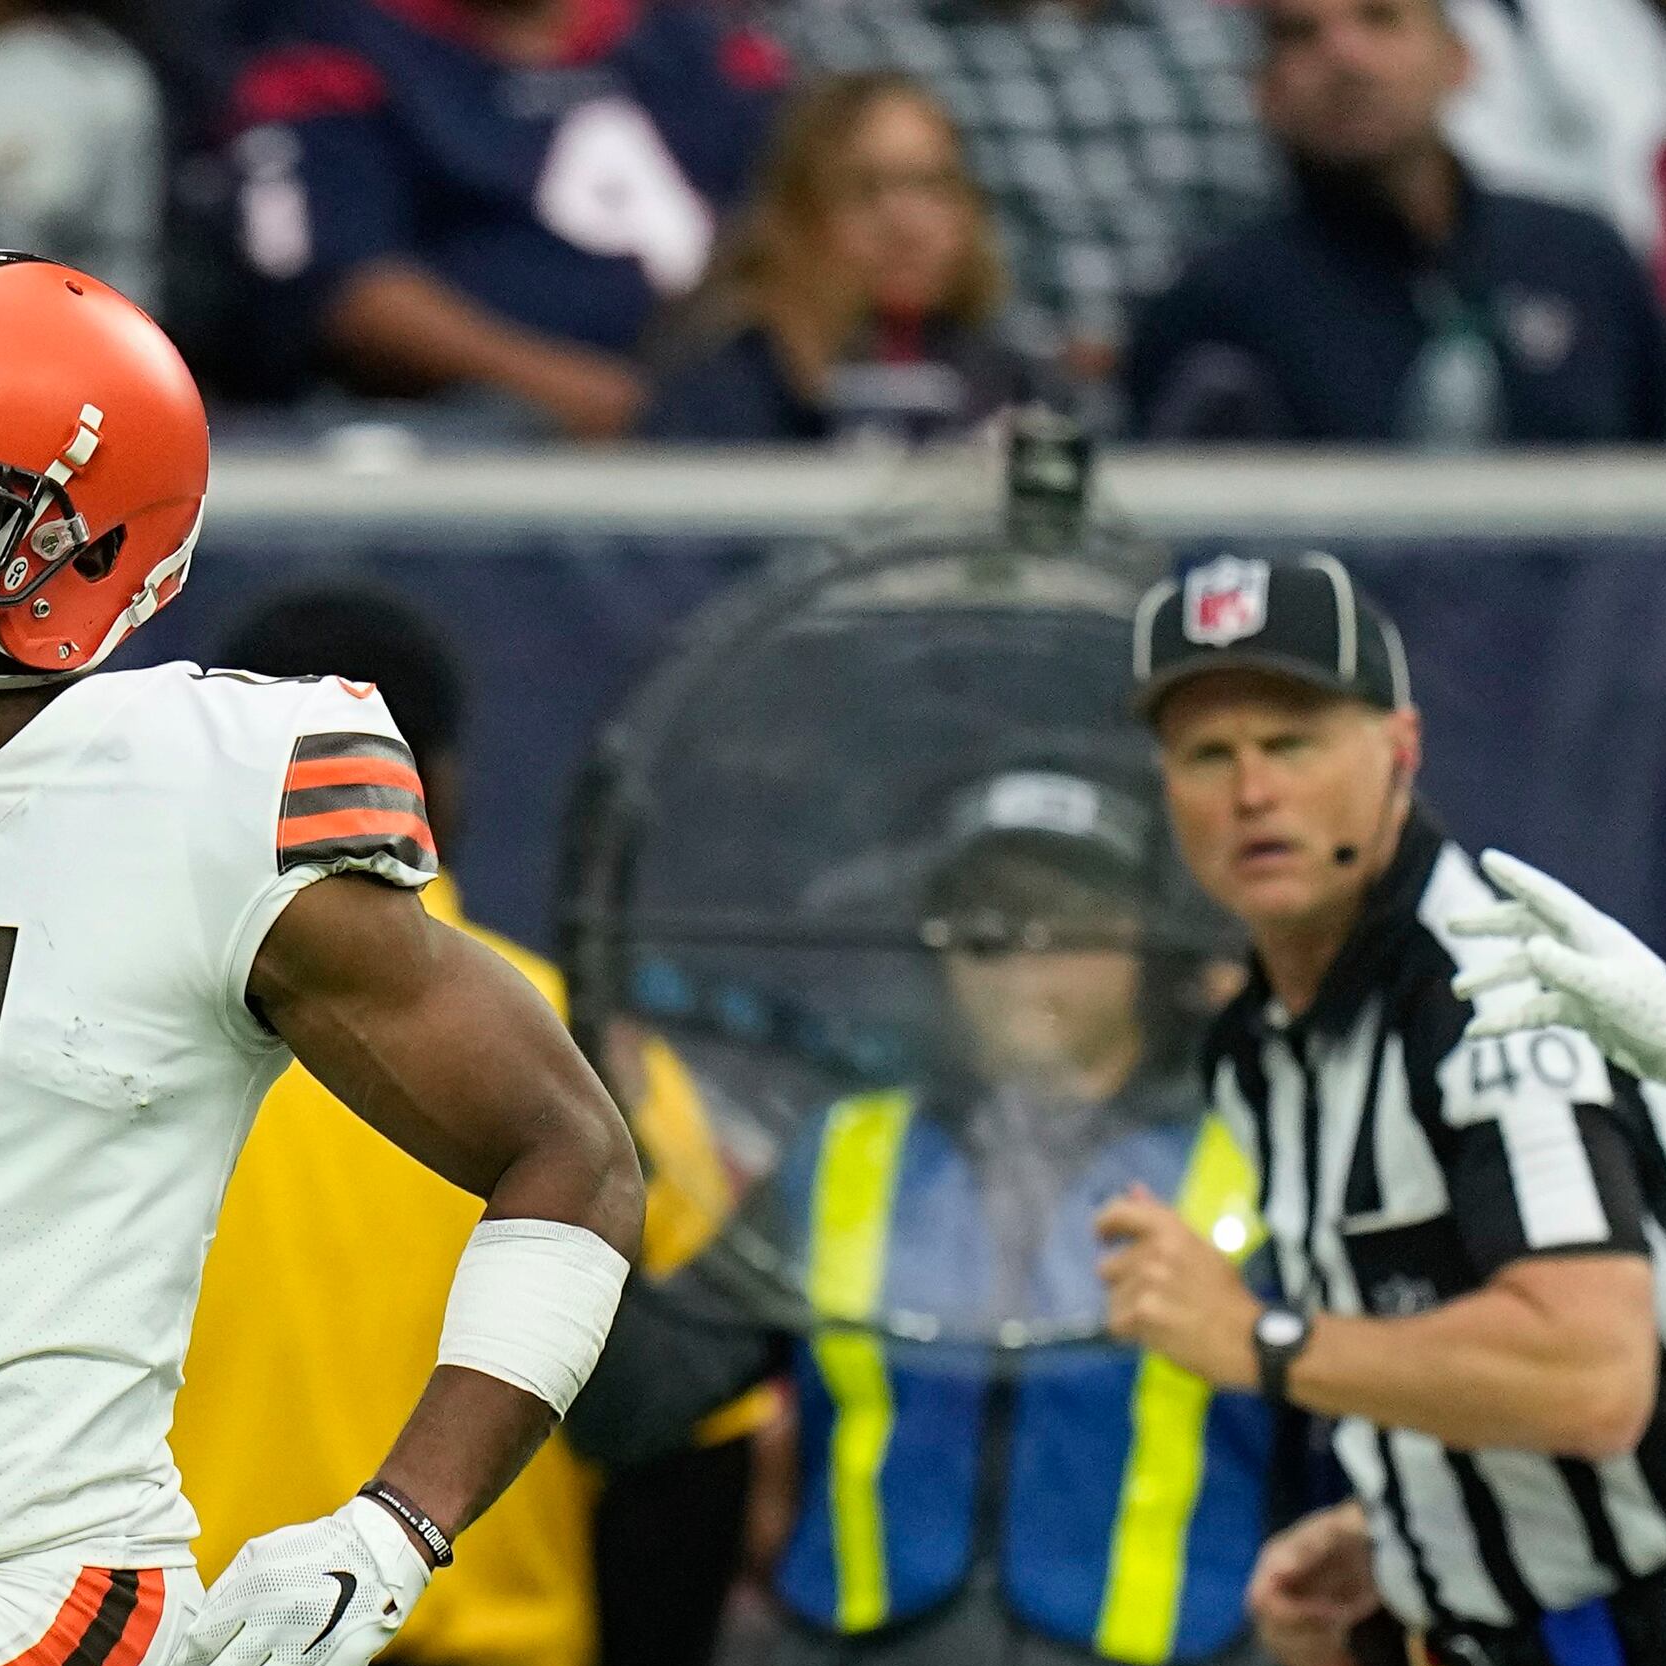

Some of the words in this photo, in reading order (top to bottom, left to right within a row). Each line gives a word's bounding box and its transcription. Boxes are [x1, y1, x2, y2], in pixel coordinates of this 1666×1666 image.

[1470, 1032, 1580, 1093] 40
[418, 1517, 431, 1532] &
[424, 1525, 450, 1558] LORD
